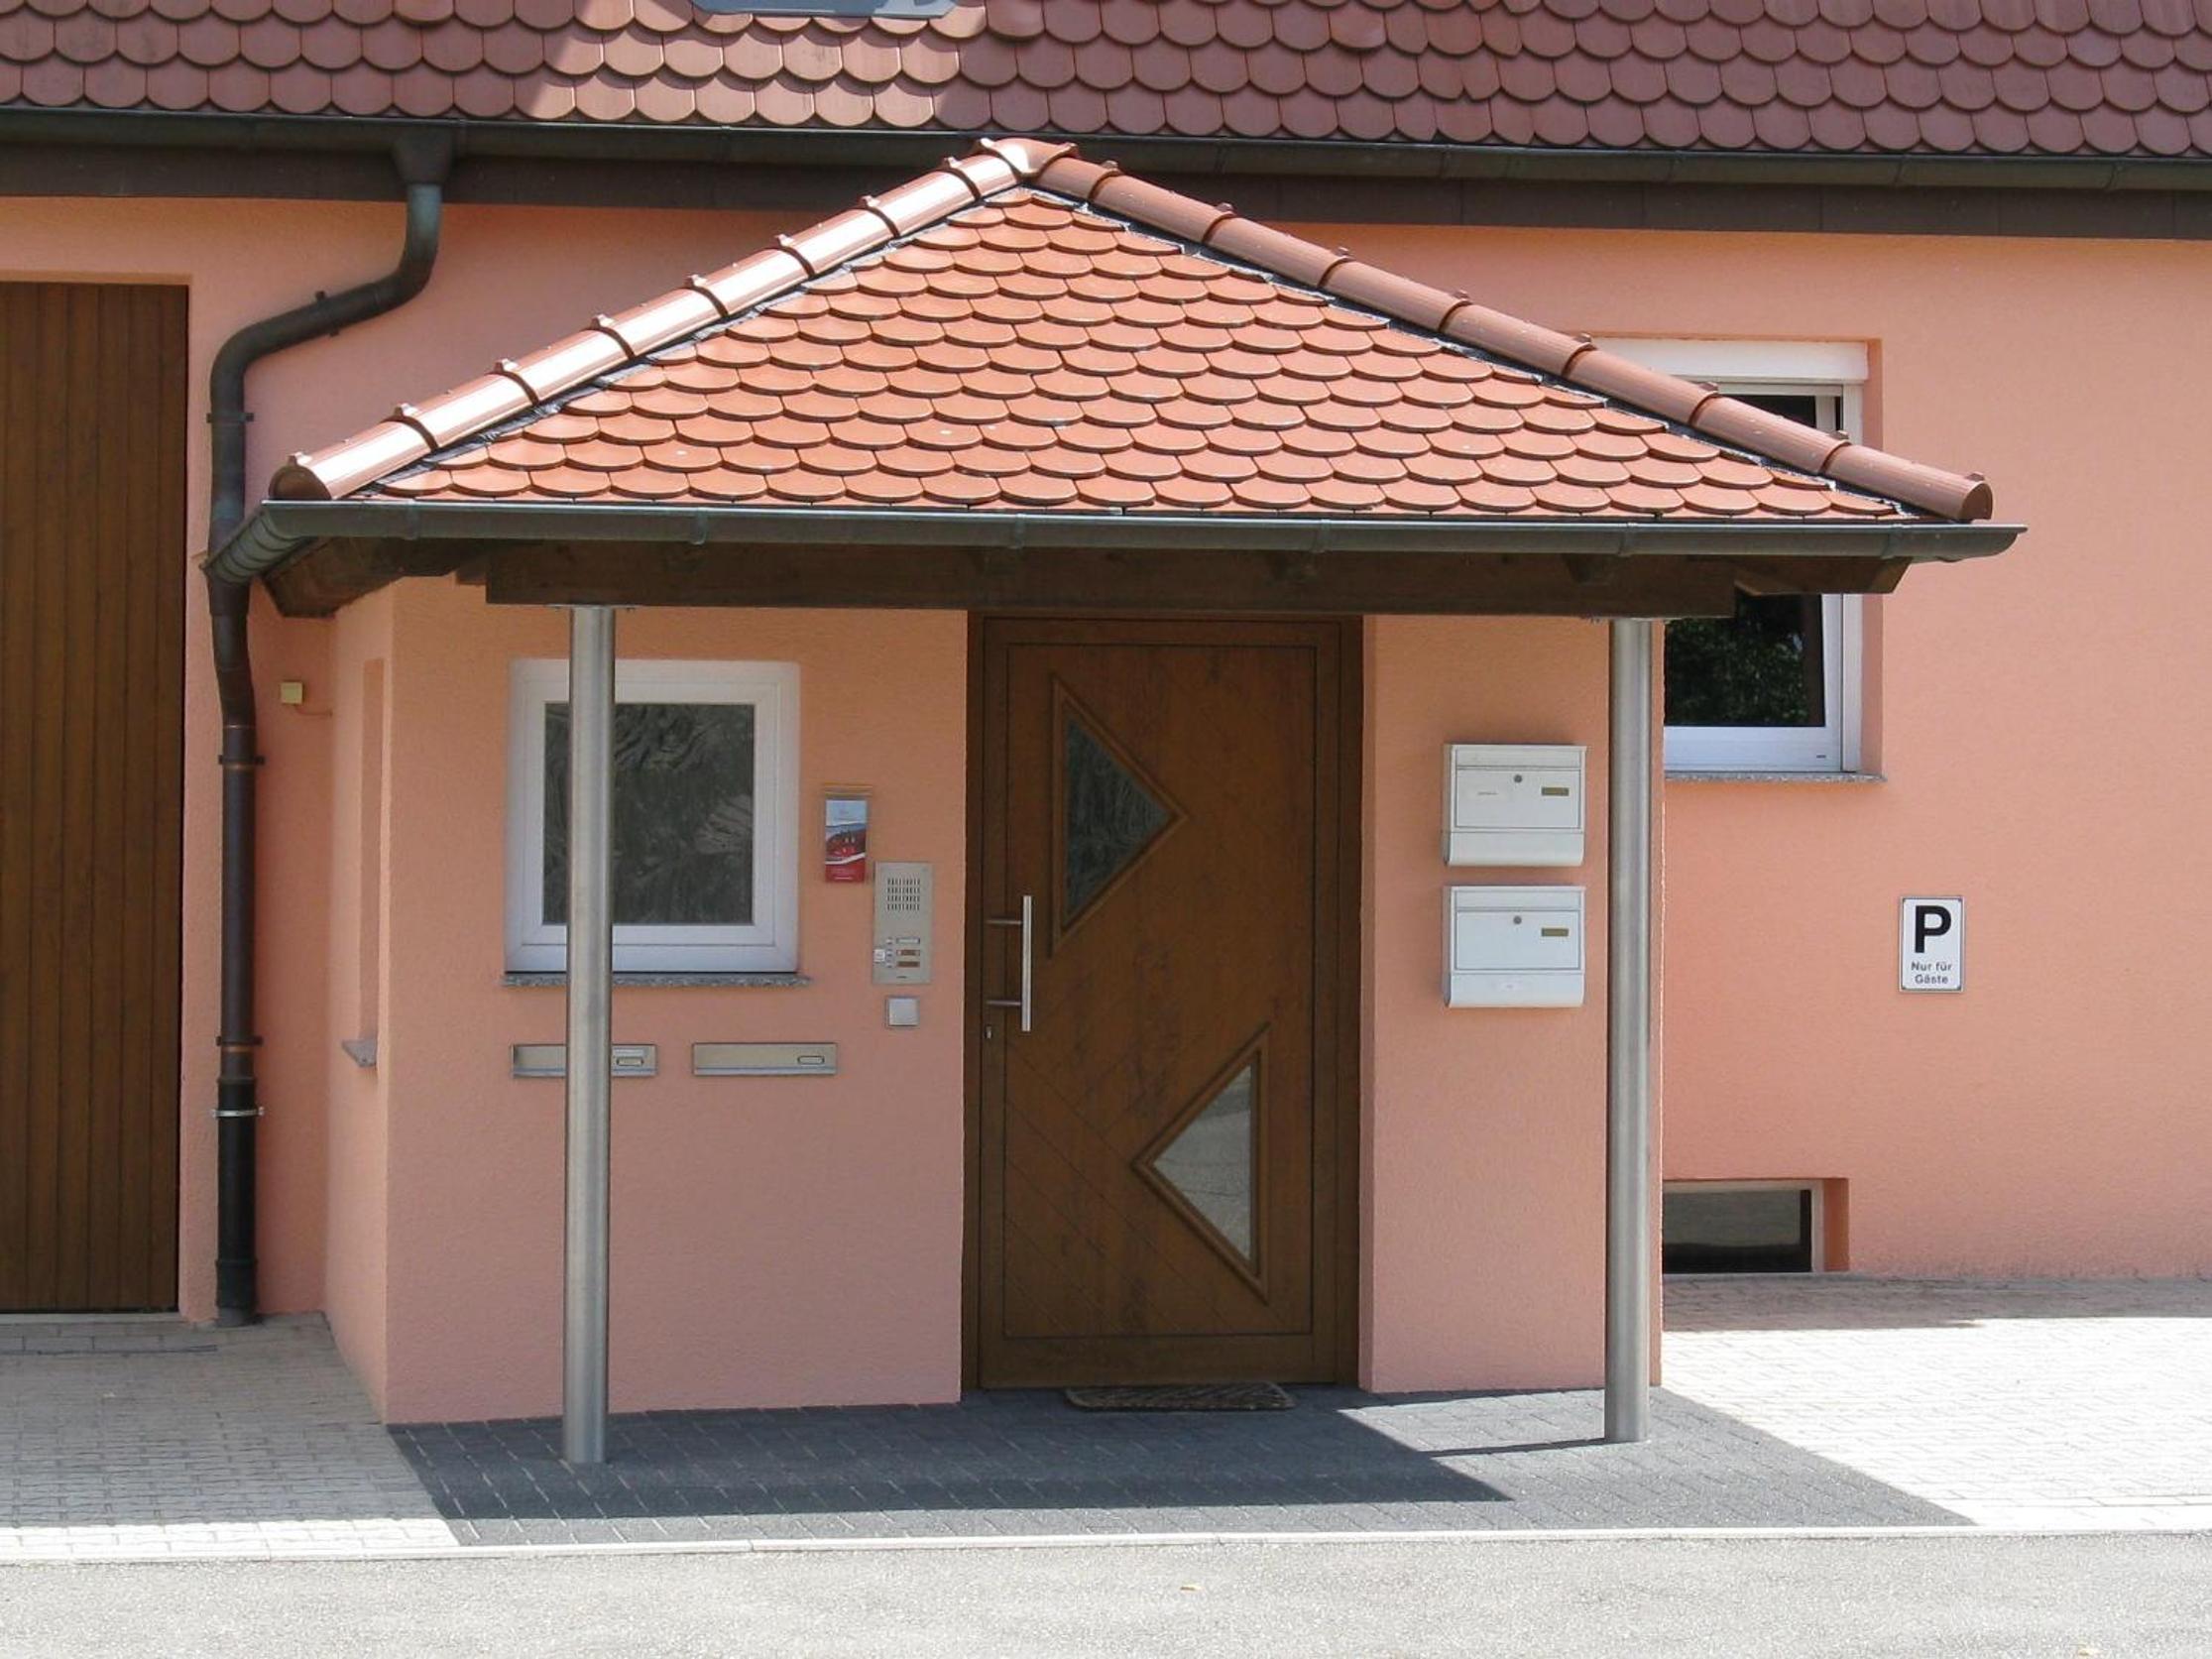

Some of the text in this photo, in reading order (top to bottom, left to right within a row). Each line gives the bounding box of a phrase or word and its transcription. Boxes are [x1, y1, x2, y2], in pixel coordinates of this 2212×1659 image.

[1915, 905, 1951, 953] P
[1911, 961, 1952, 971] Nur für
[1915, 974, 1948, 984] Gäste
